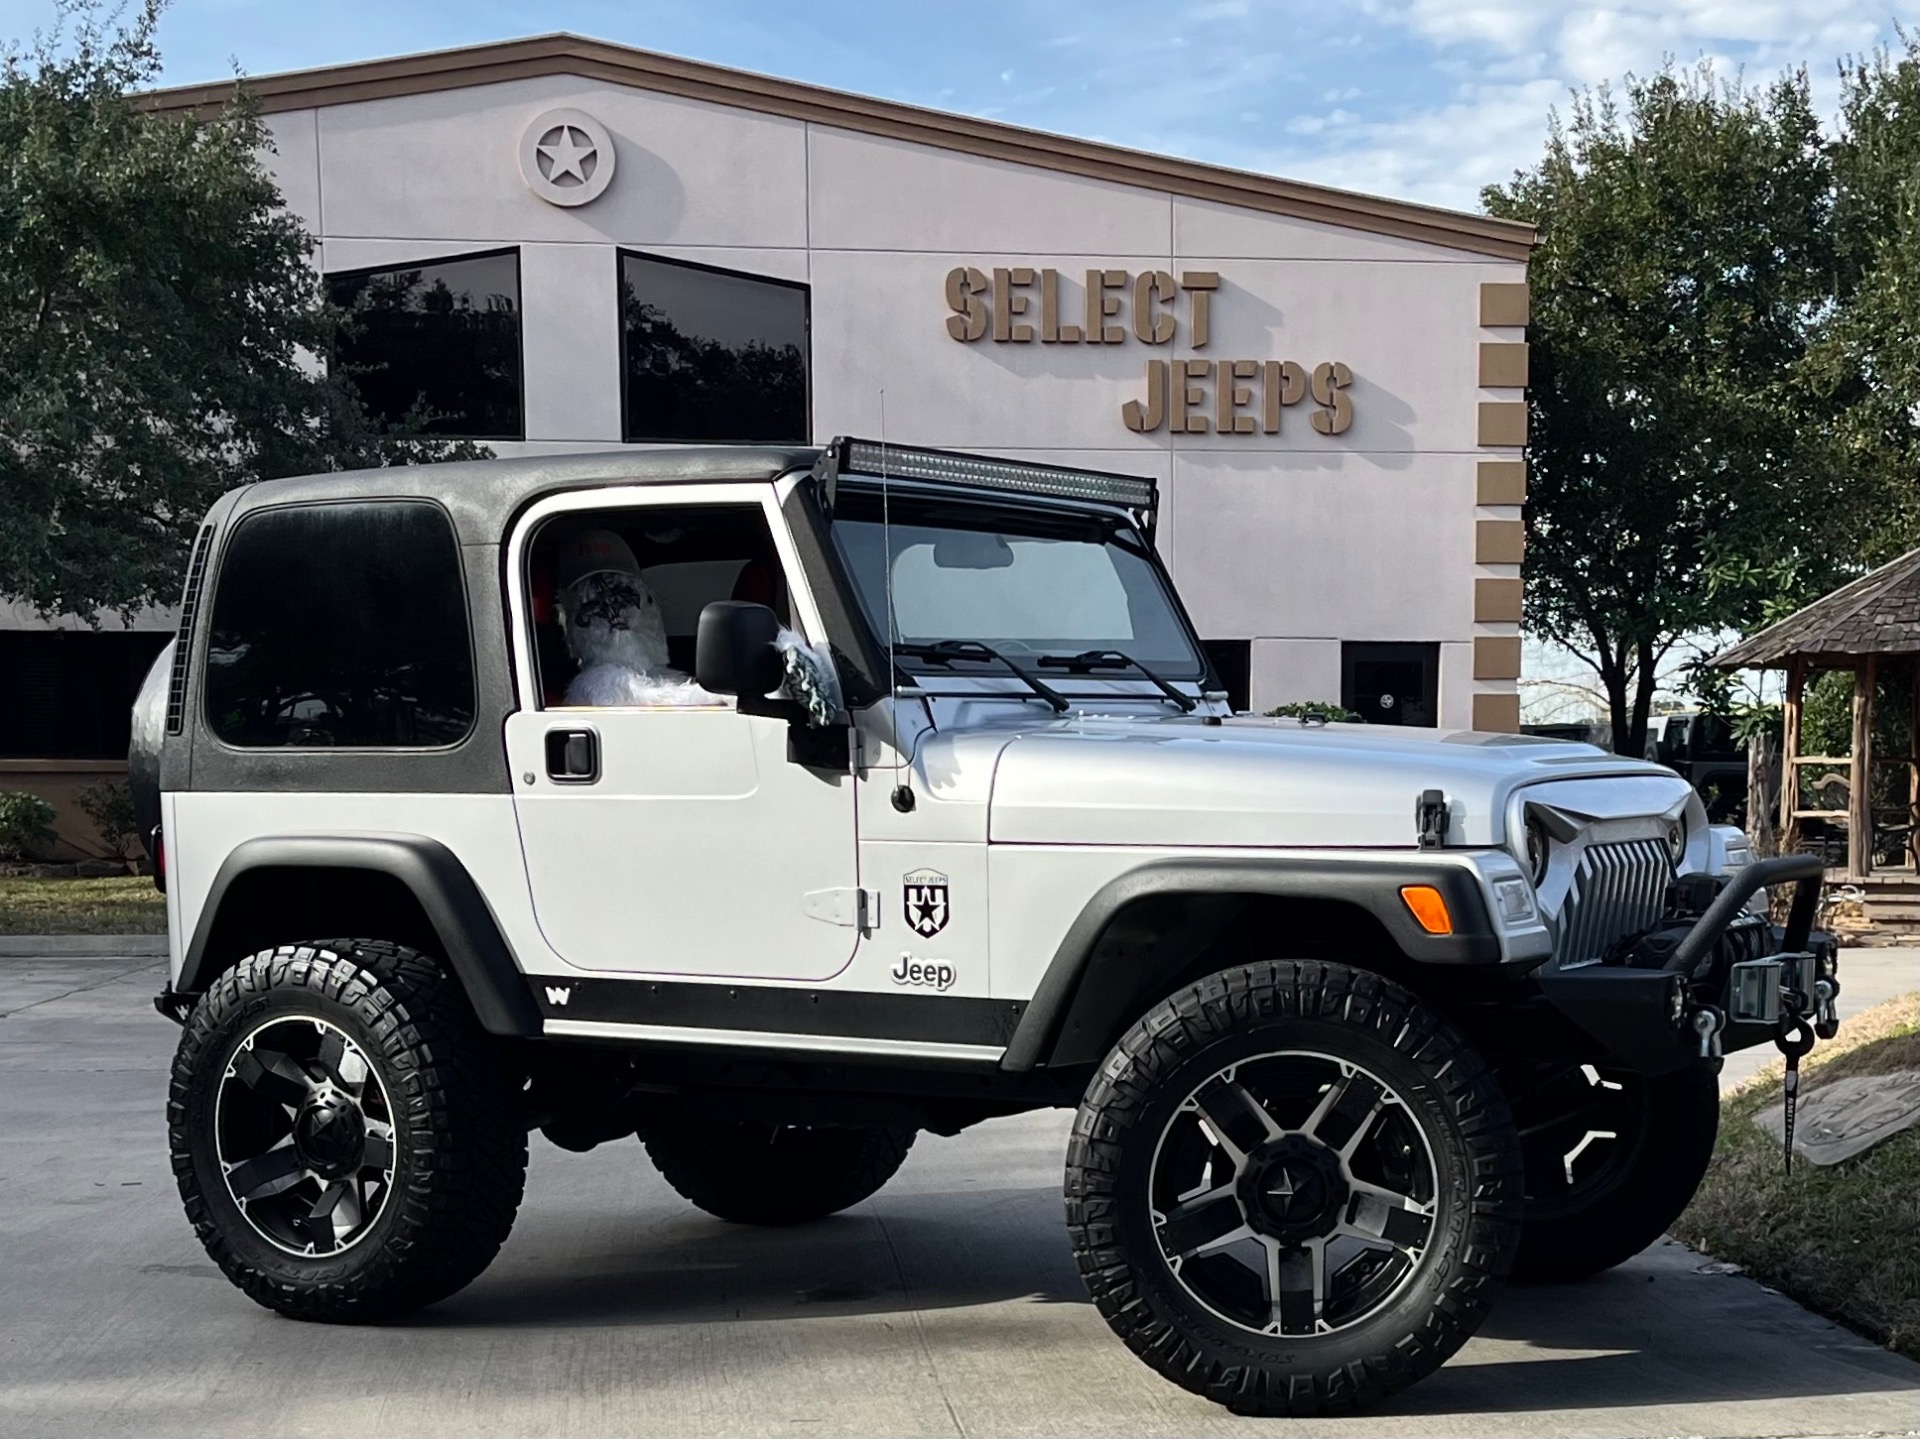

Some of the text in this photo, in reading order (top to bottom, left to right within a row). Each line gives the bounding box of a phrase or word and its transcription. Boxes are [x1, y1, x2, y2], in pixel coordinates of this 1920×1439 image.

[945, 267, 1219, 349] SELECT
[1122, 359, 1353, 434] JEEPS
[905, 876, 947, 884] SELECT JEEPS
[892, 956, 953, 988] Jeep
